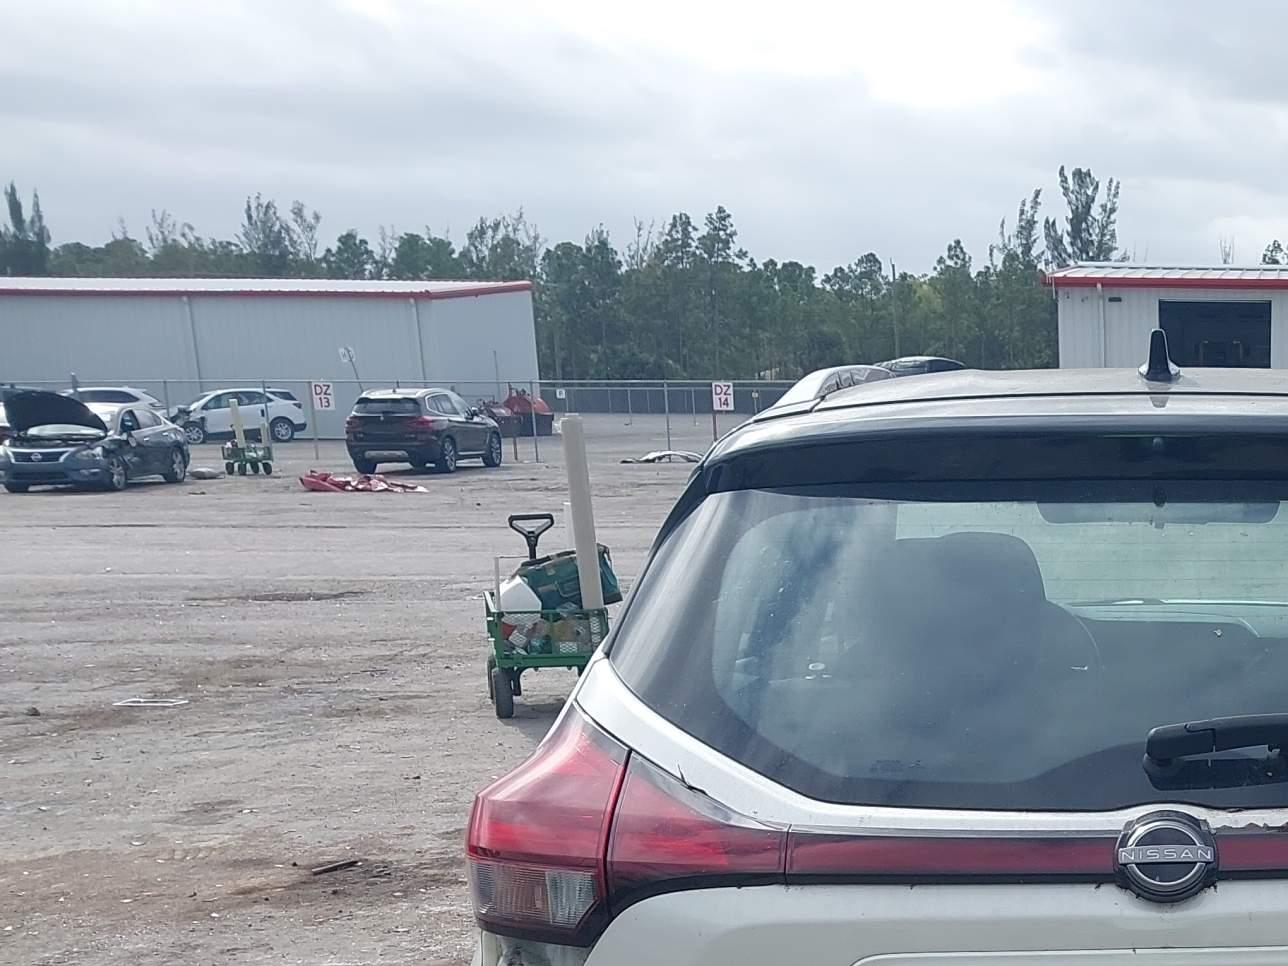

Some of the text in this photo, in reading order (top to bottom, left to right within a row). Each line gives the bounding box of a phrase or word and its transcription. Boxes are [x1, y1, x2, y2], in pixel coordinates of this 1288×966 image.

[314, 384, 331, 396] DZ
[714, 384, 732, 396] DZ
[319, 397, 331, 408] 13
[718, 397, 729, 408] 14
[1121, 848, 1211, 861] NISSAN
